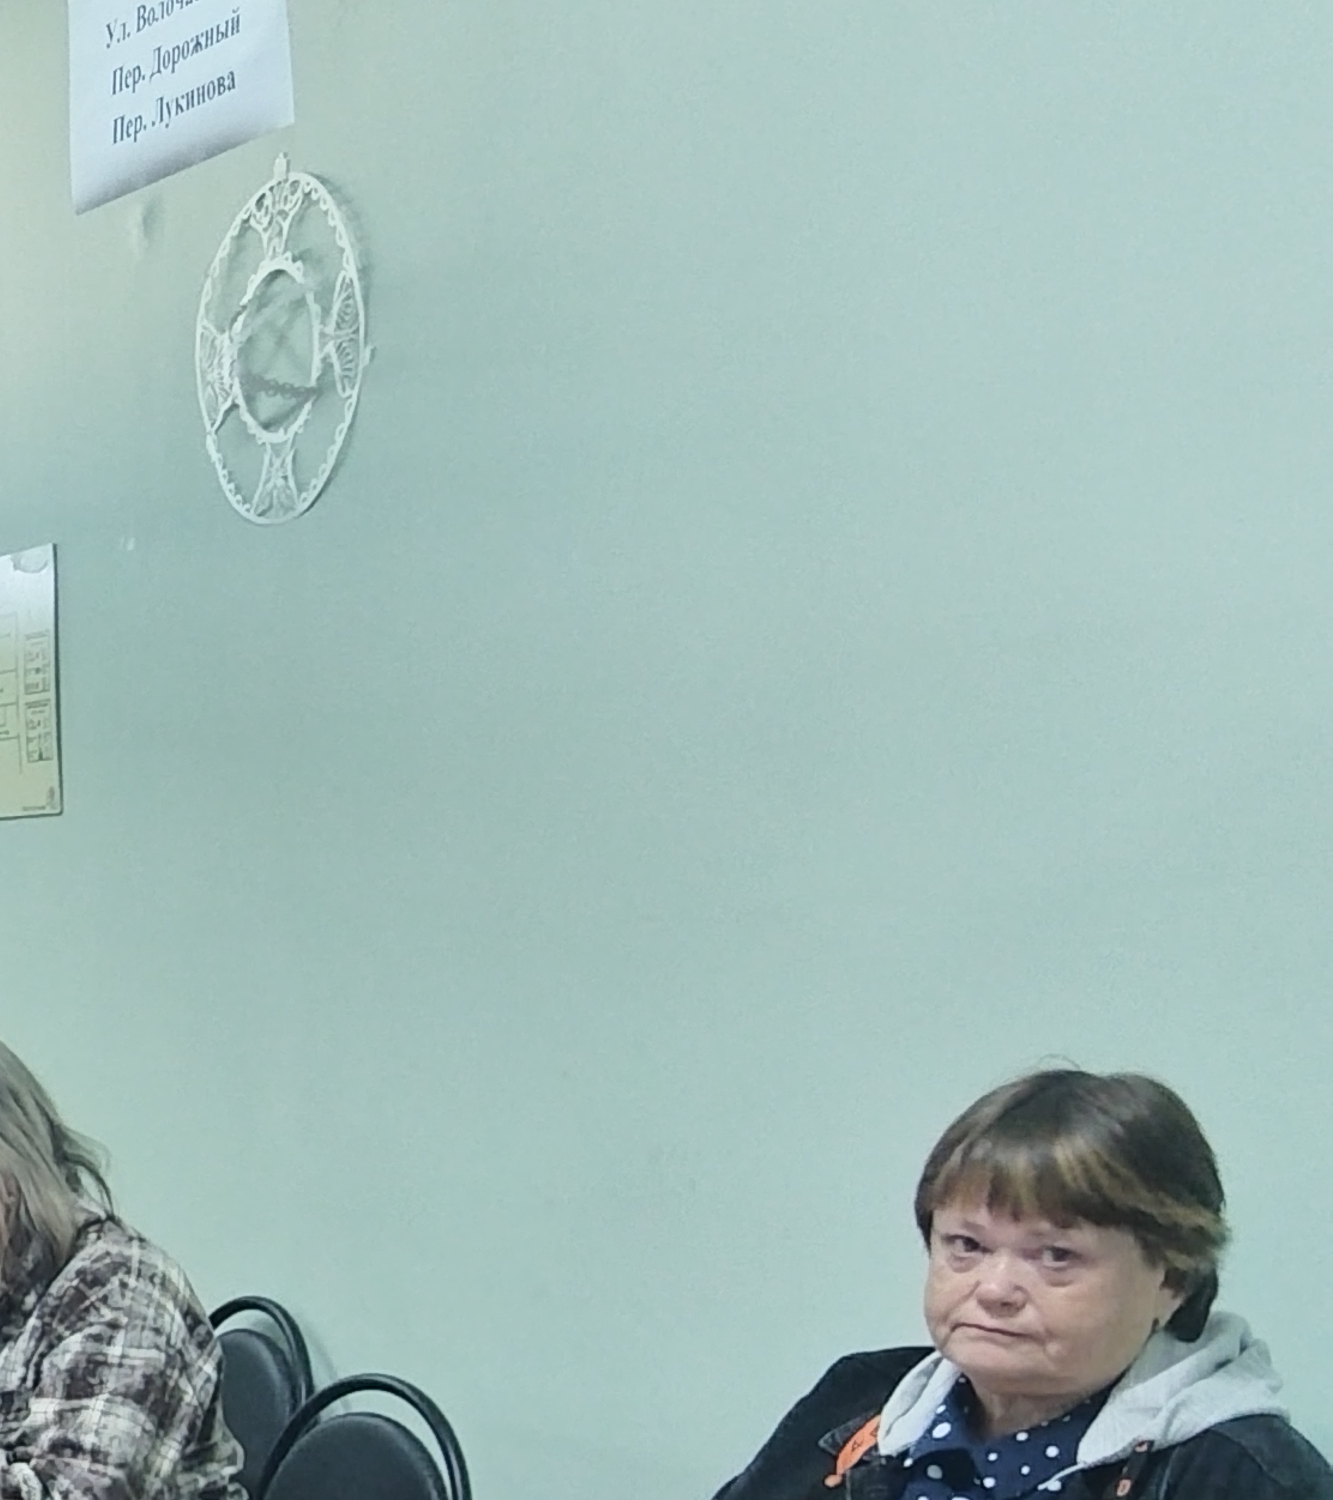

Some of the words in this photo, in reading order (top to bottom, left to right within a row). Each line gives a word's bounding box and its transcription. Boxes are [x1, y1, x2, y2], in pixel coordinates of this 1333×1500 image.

[106, 17, 131, 49] Ул.
[111, 64, 146, 96] Пер.
[149, 7, 241, 84] Дорожный
[112, 114, 148, 144] Пер.
[151, 70, 236, 129] Лукинова
